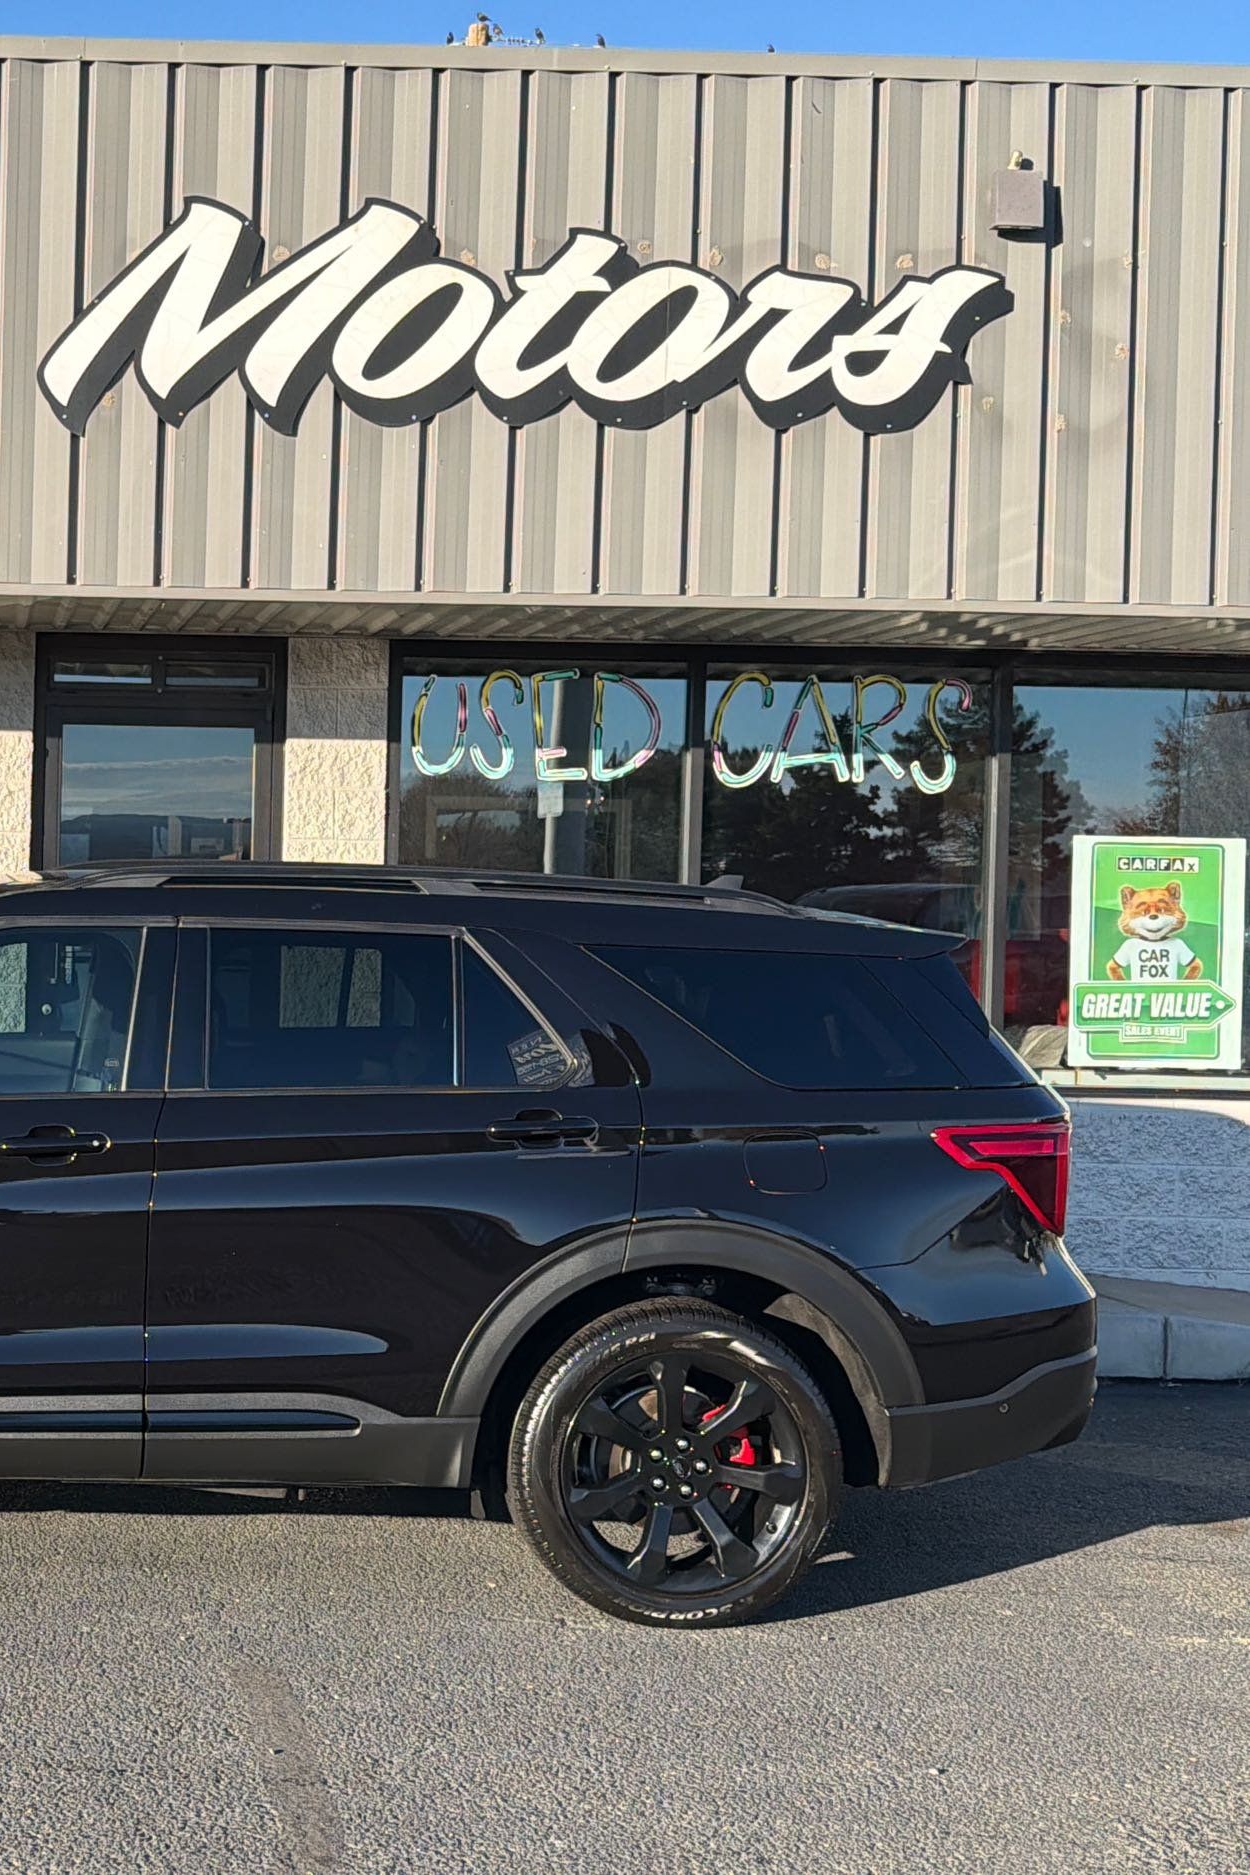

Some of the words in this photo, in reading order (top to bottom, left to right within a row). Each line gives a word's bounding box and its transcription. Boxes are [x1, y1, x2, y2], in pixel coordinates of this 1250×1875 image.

[40, 198, 1005, 412] Motors
[411, 668, 663, 782] USED
[712, 672, 973, 795] CARS
[1138, 949, 1170, 963] CAR
[1139, 964, 1170, 979] FOX
[1081, 992, 1146, 1019] GREAT
[1149, 992, 1212, 1018] VALUE
